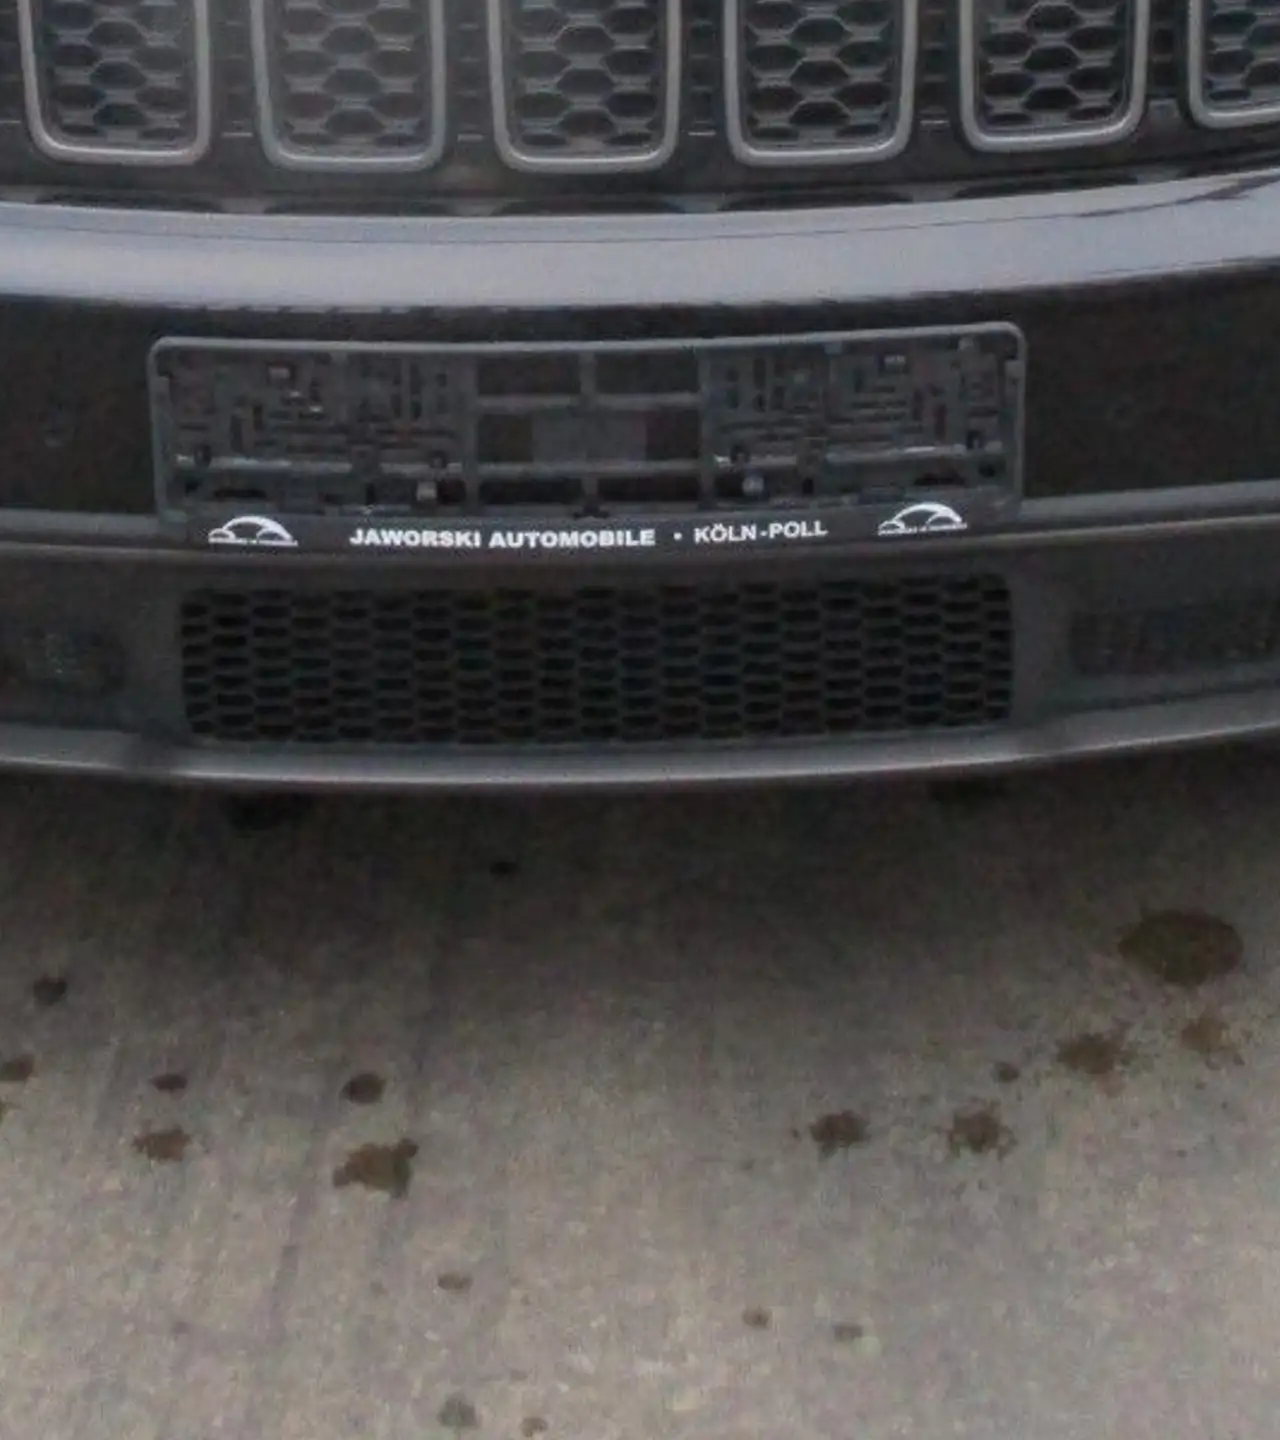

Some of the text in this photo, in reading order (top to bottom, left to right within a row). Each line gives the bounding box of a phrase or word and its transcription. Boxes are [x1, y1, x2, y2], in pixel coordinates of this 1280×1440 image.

[349, 520, 829, 548] JAWORSKI AUTOMOBILE KÖLN-POLL
